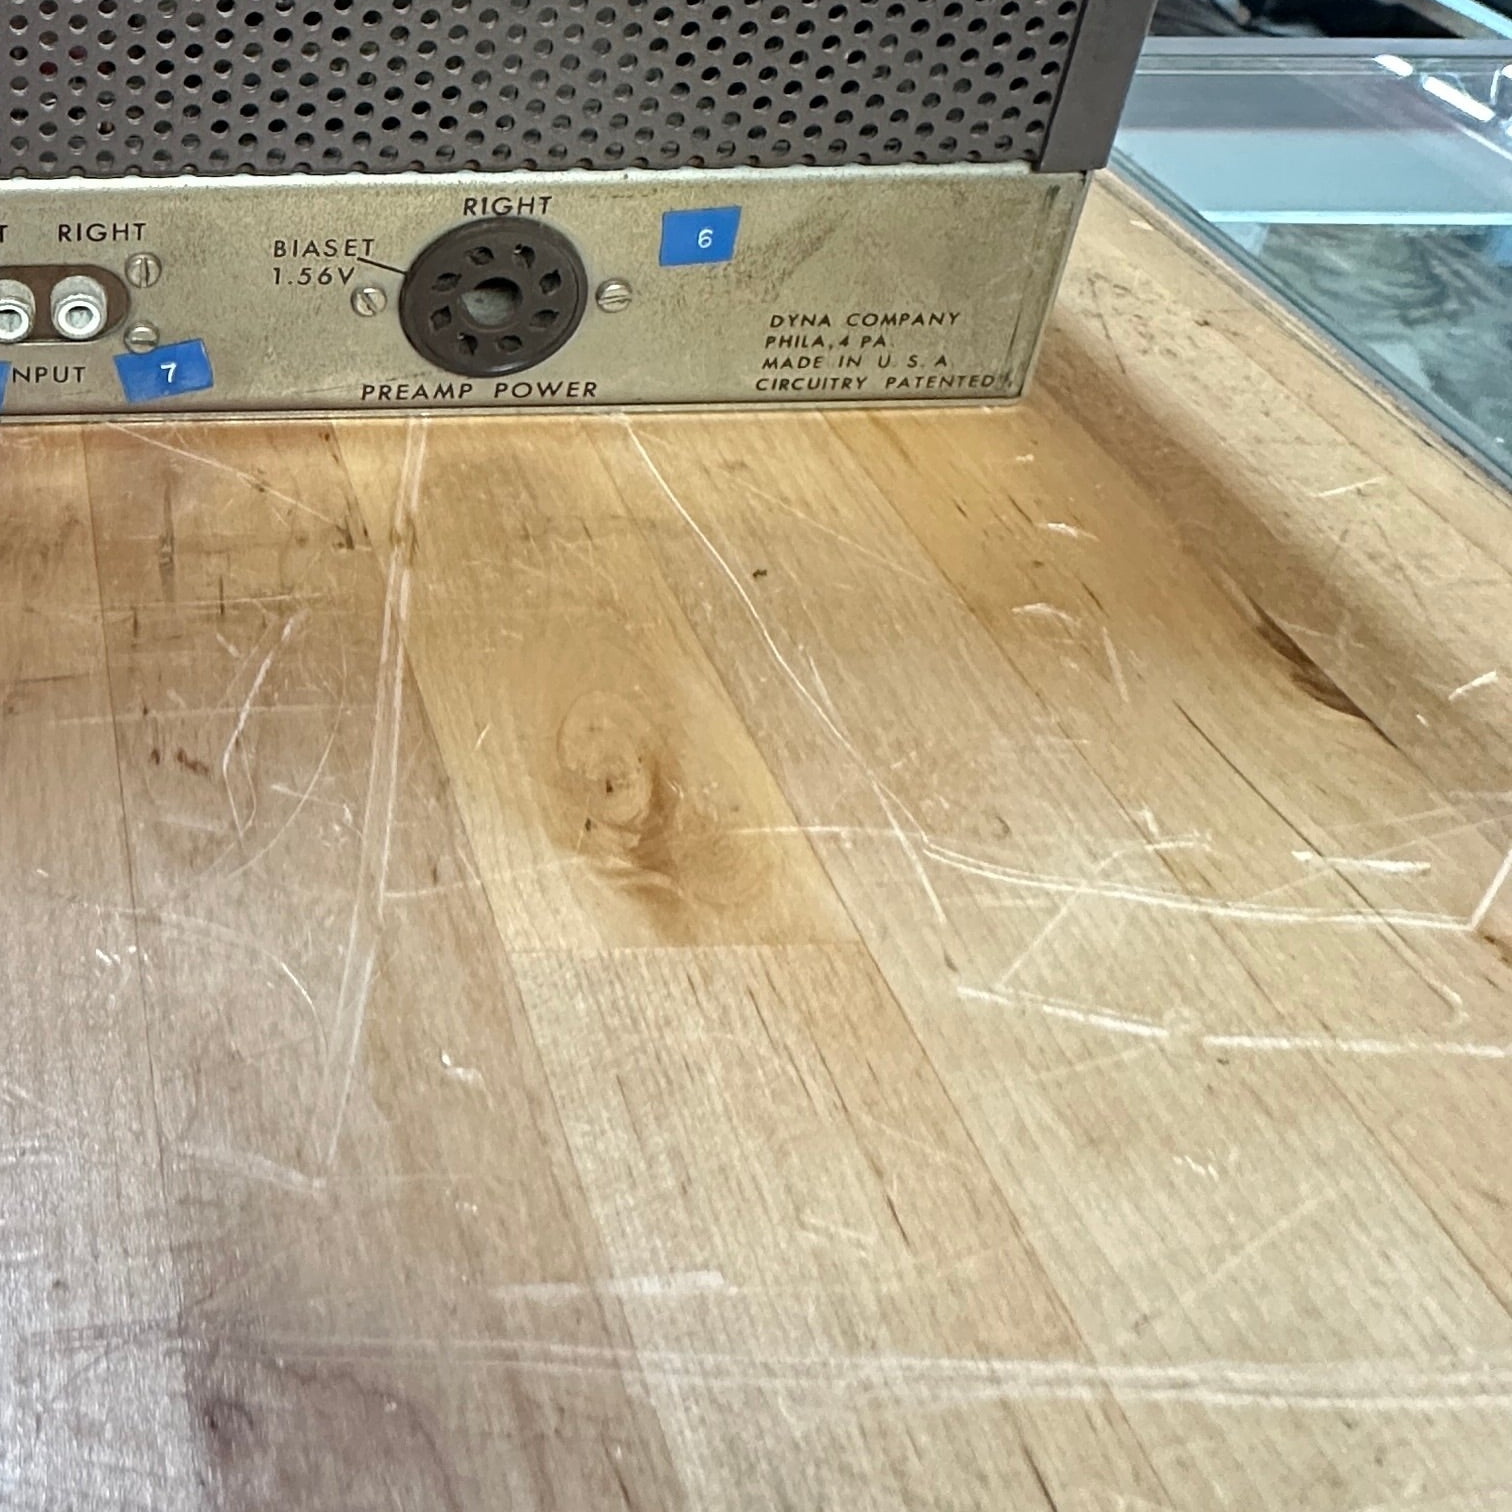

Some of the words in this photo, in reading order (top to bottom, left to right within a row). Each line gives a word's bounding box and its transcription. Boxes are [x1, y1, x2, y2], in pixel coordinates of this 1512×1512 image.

[462, 194, 553, 217] RIGHT
[58, 222, 147, 243] RIGHT
[697, 228, 714, 249] 6
[273, 238, 375, 258] BIASET
[273, 266, 355, 286] 1.56V
[769, 313, 831, 329] DYNA
[846, 311, 961, 328] COMPANY
[160, 361, 177, 383] 7
[761, 355, 824, 370] MADE
[838, 354, 863, 369] IN
[12, 365, 86, 384] NPUT
[755, 376, 868, 392] CIRCUITRY
[885, 374, 996, 389] PATENTED
[360, 382, 473, 401] PREAMP
[493, 380, 598, 400] POWER
